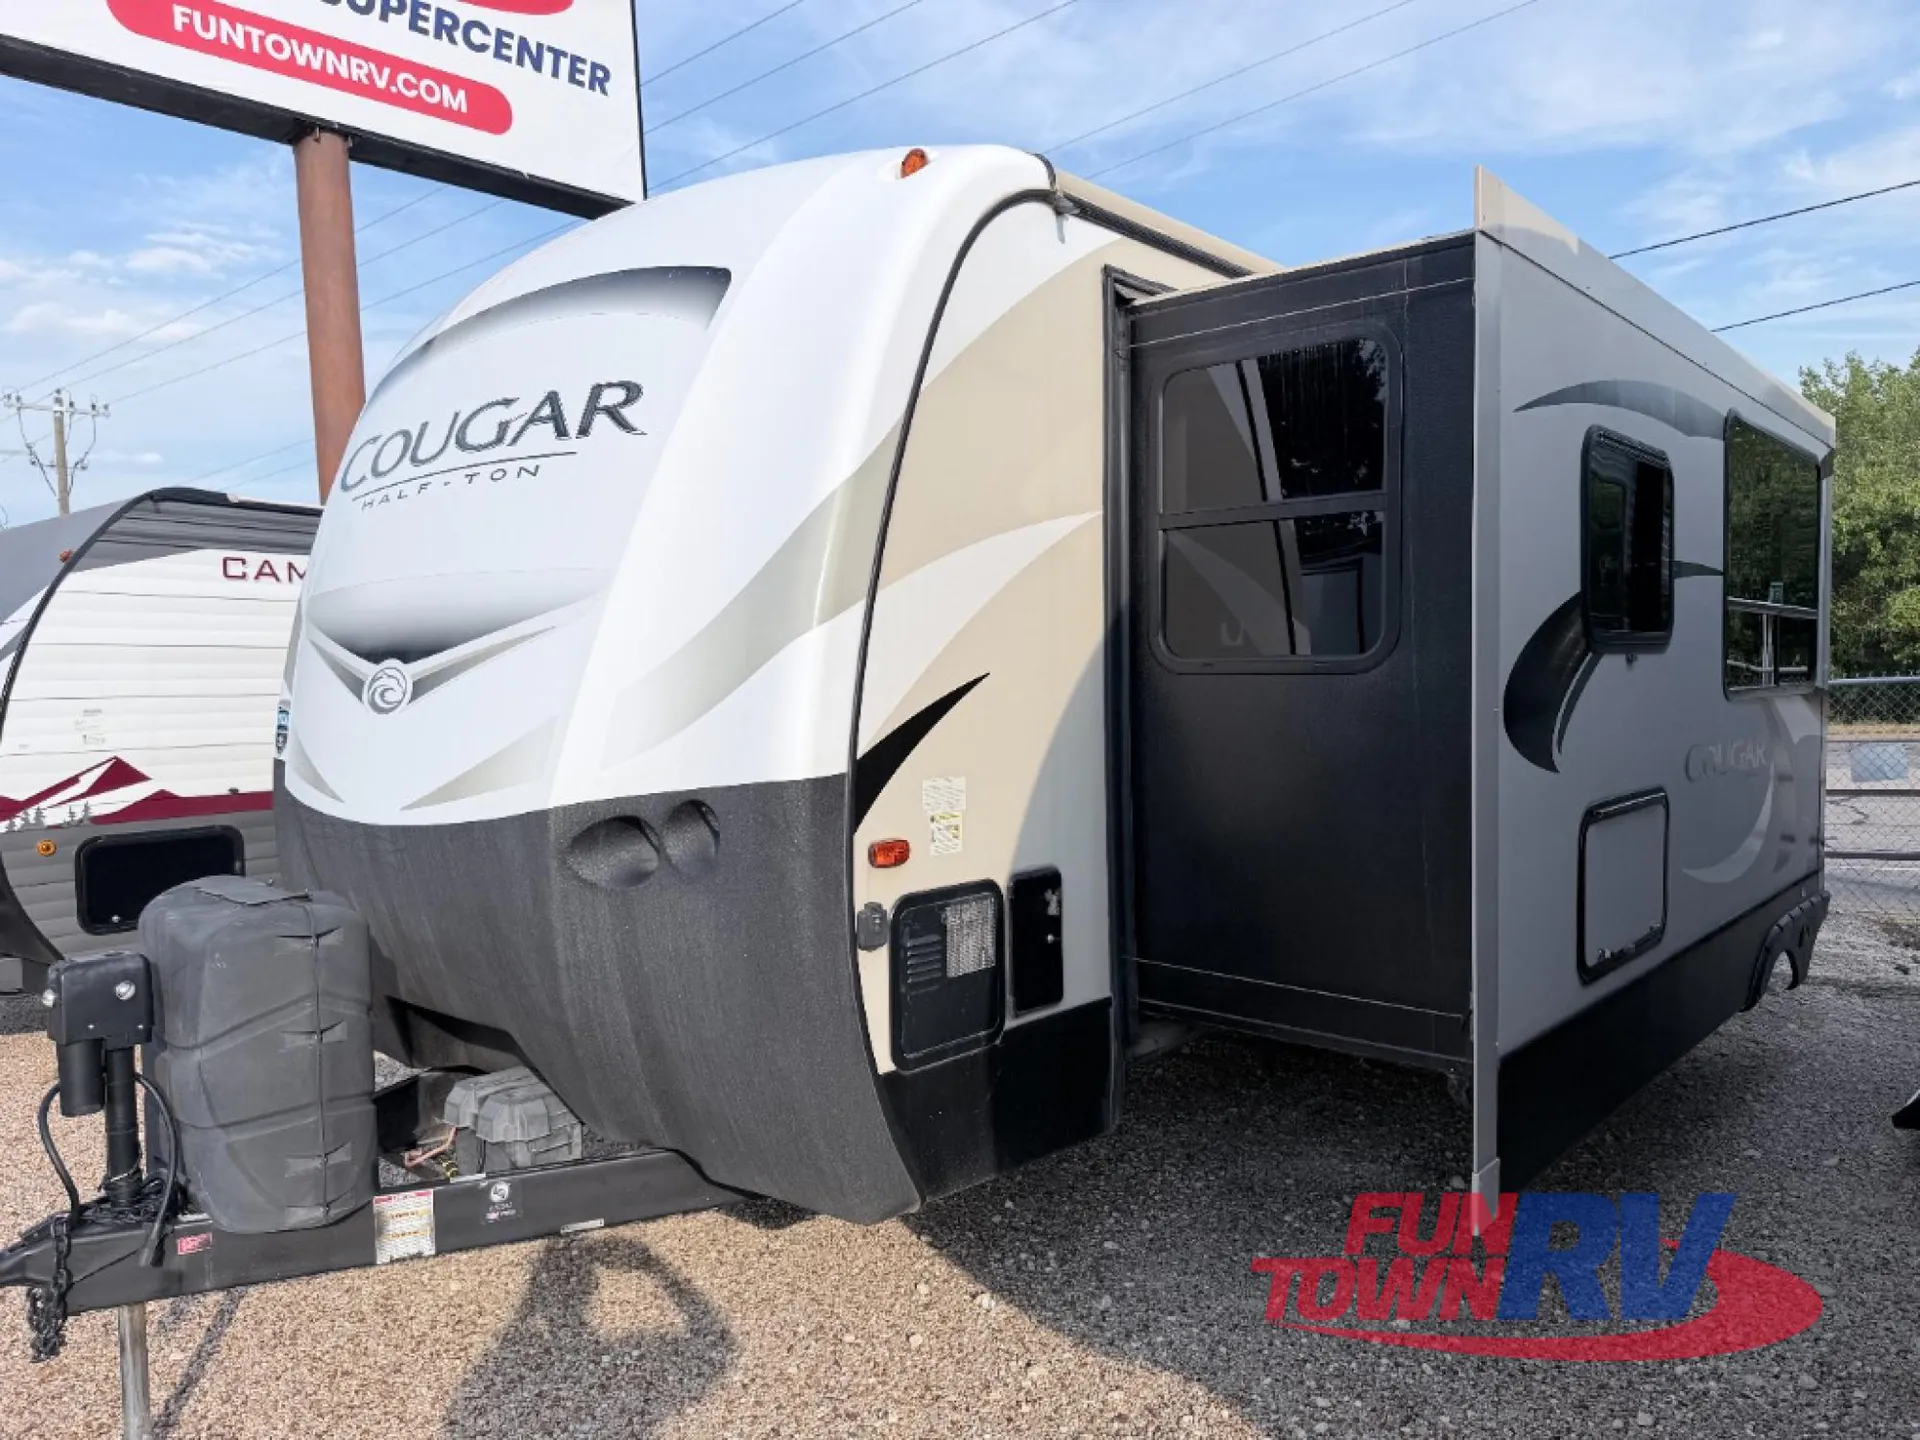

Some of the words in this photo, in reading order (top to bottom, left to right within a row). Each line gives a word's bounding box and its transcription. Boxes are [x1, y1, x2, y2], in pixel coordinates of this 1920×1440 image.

[173, 4, 467, 113] FUNTOWNRV.COM
[321, 0, 612, 96] UPERCENTER
[340, 380, 648, 492] COUGAR
[361, 464, 540, 511] HALF-TON
